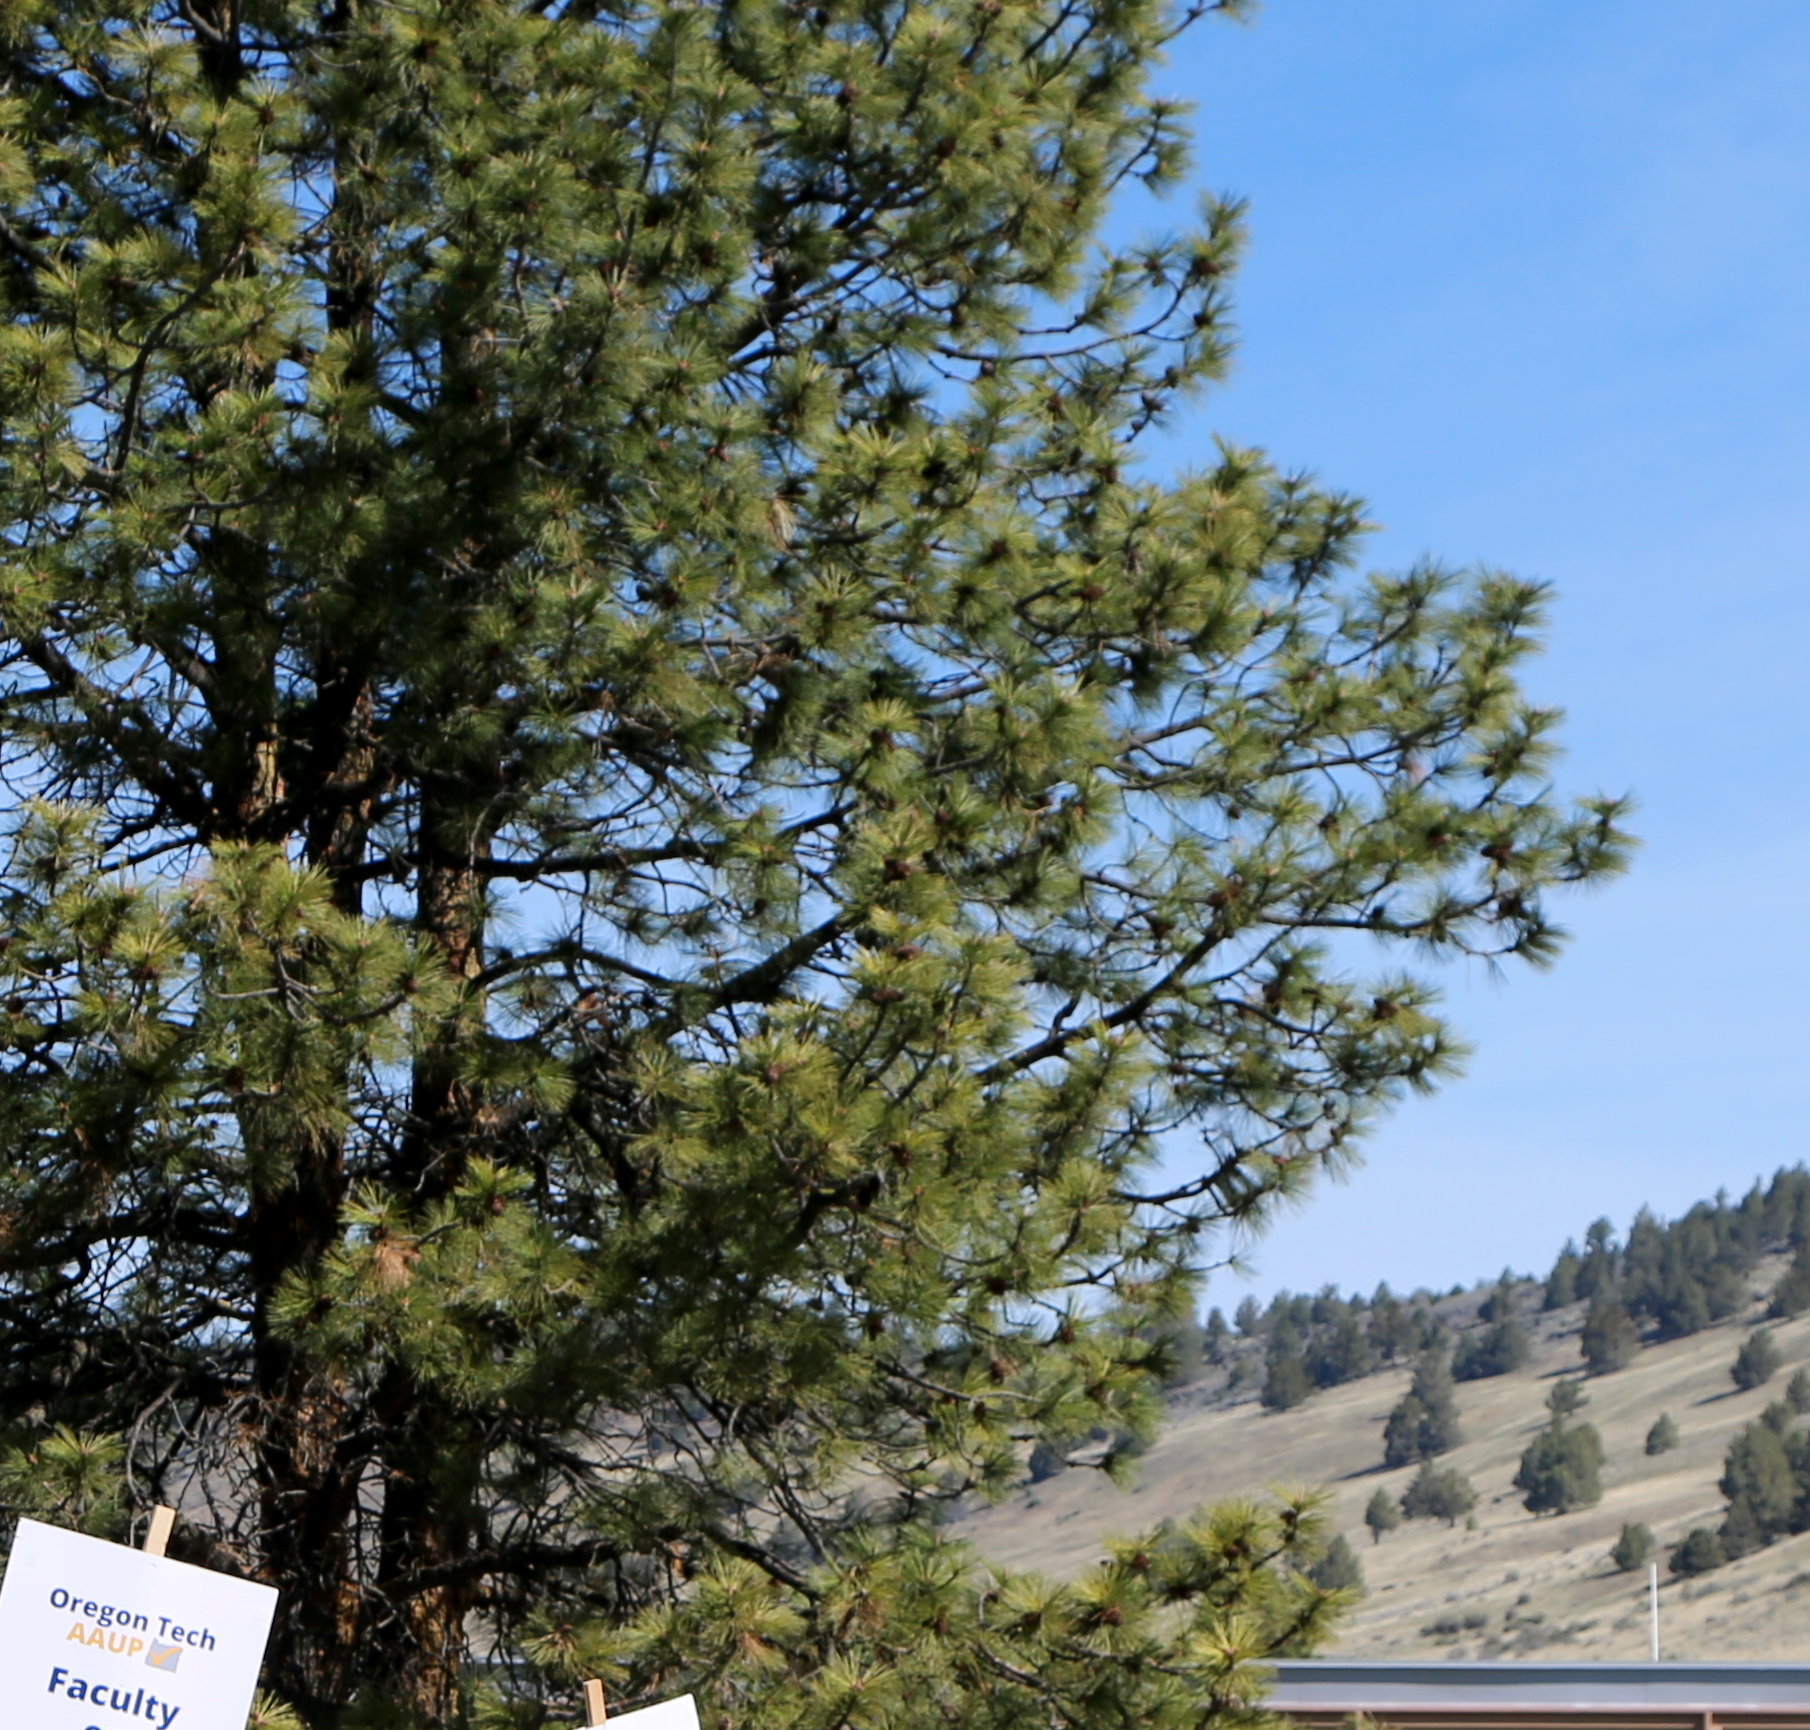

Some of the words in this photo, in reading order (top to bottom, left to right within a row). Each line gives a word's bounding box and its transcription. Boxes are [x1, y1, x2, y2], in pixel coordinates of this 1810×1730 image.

[49, 1587, 149, 1631] Oregon
[158, 1616, 216, 1651] Tech
[65, 1622, 144, 1657] AAUP
[47, 1667, 181, 1730] Faculty
